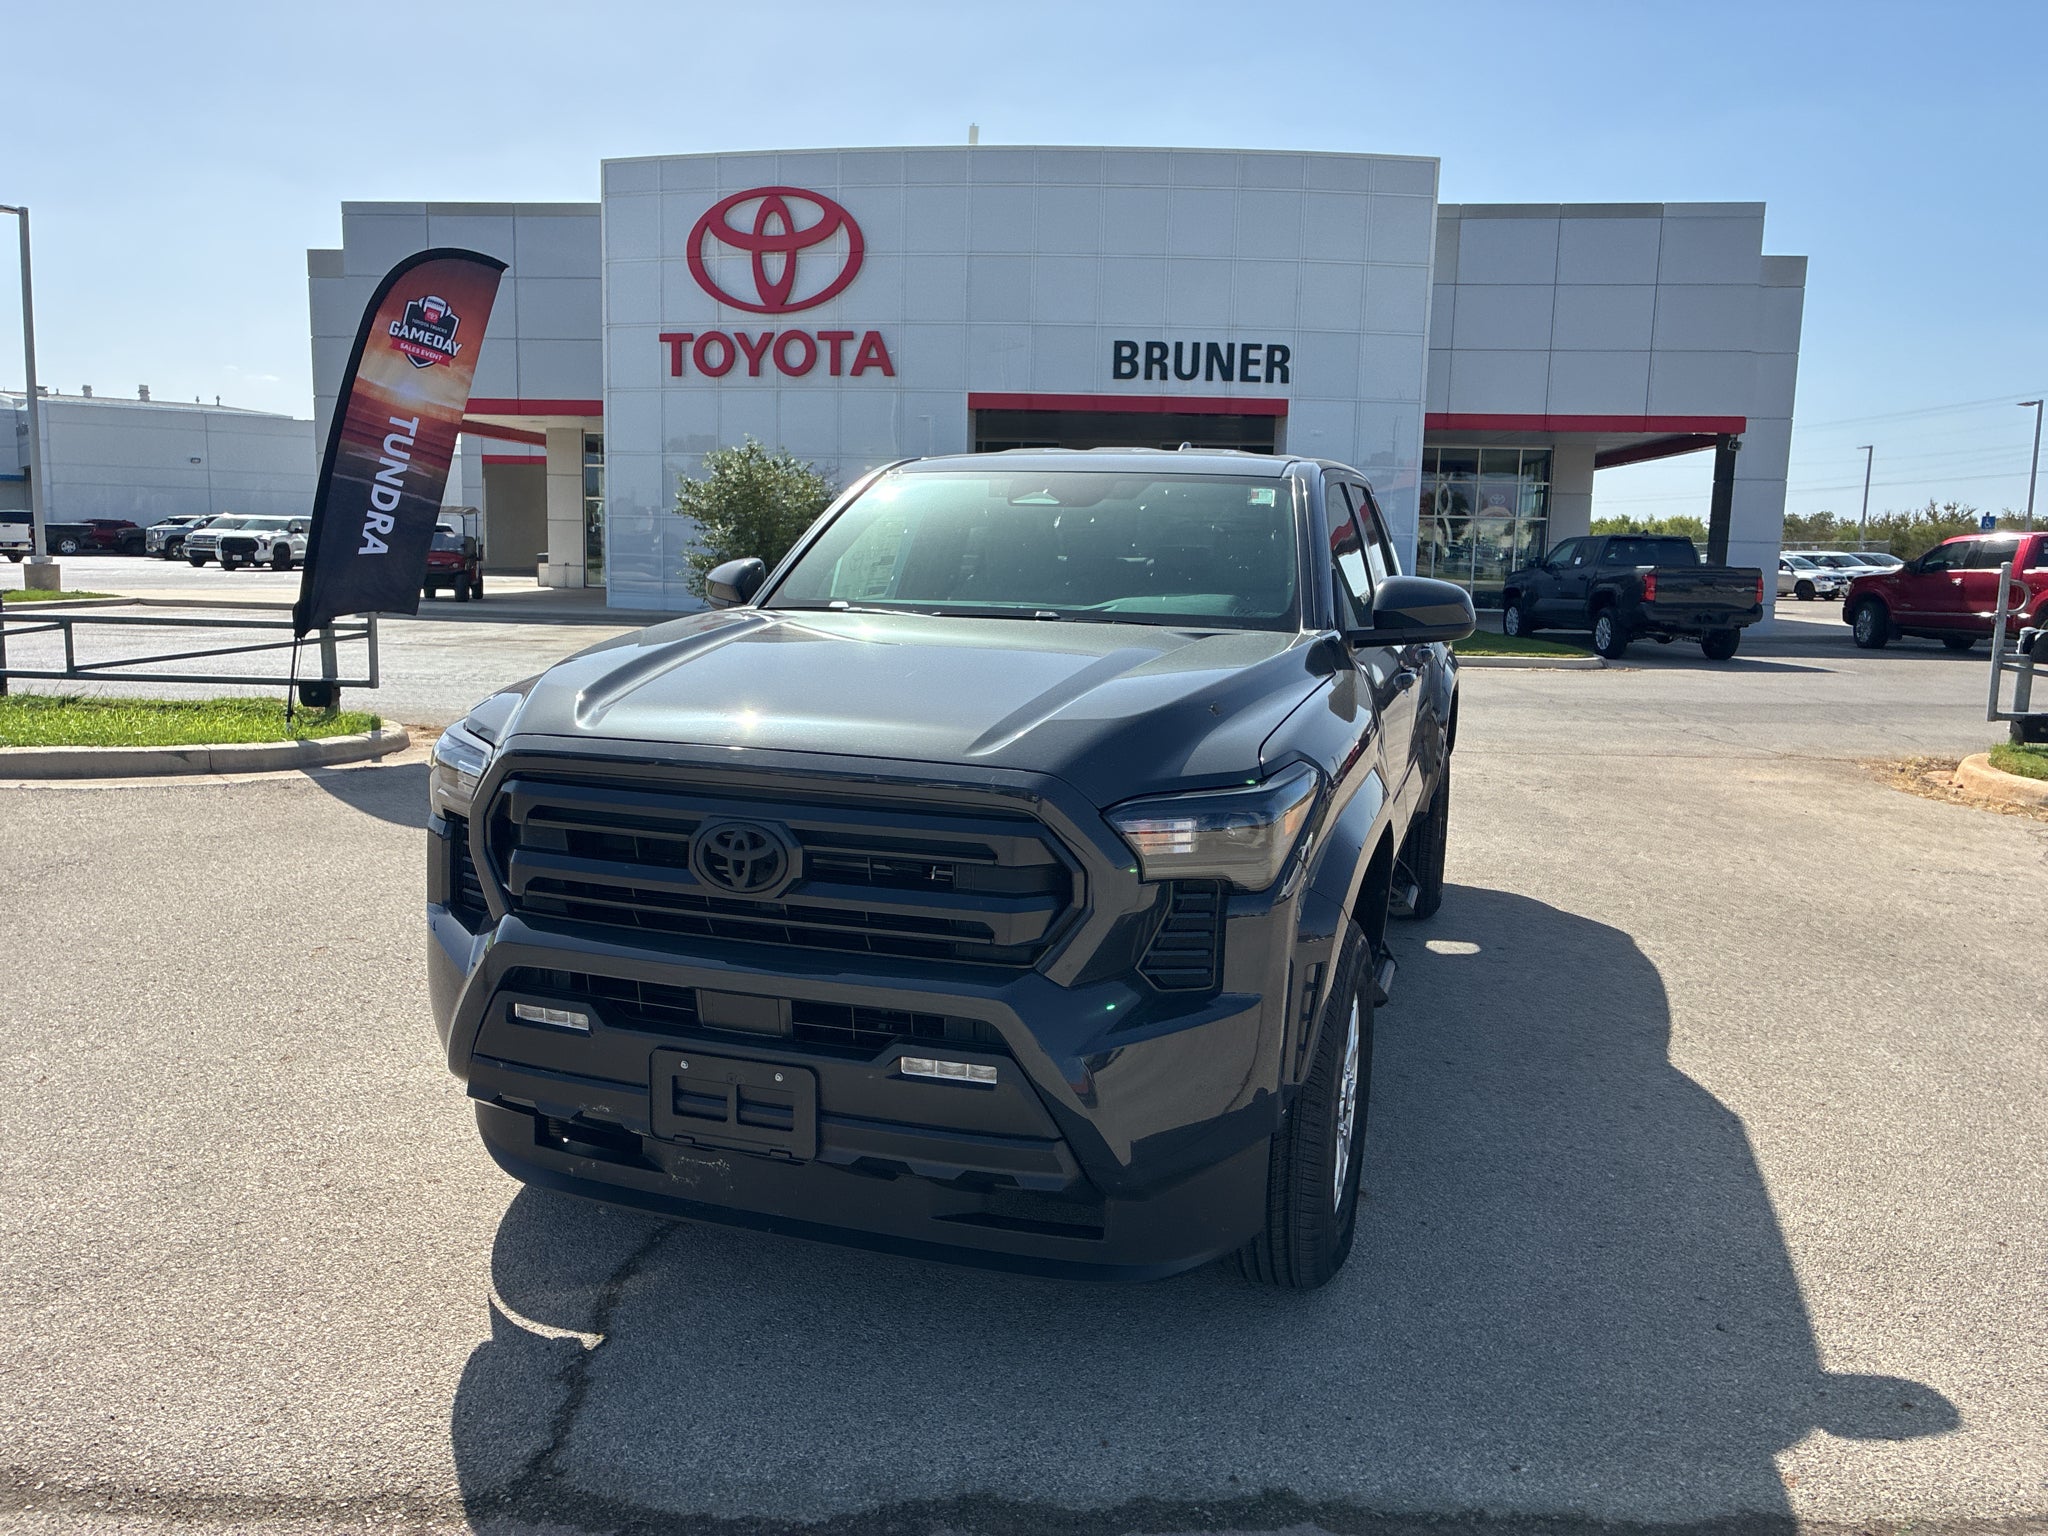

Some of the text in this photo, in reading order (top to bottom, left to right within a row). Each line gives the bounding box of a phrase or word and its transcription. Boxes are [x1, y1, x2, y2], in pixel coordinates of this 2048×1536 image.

[389, 320, 462, 356] GAMEDAY
[400, 342, 443, 361] SALES EVENT
[659, 330, 895, 377] TOYOTA
[1112, 340, 1291, 384] BRUNER
[358, 416, 420, 555] TUNDRA
